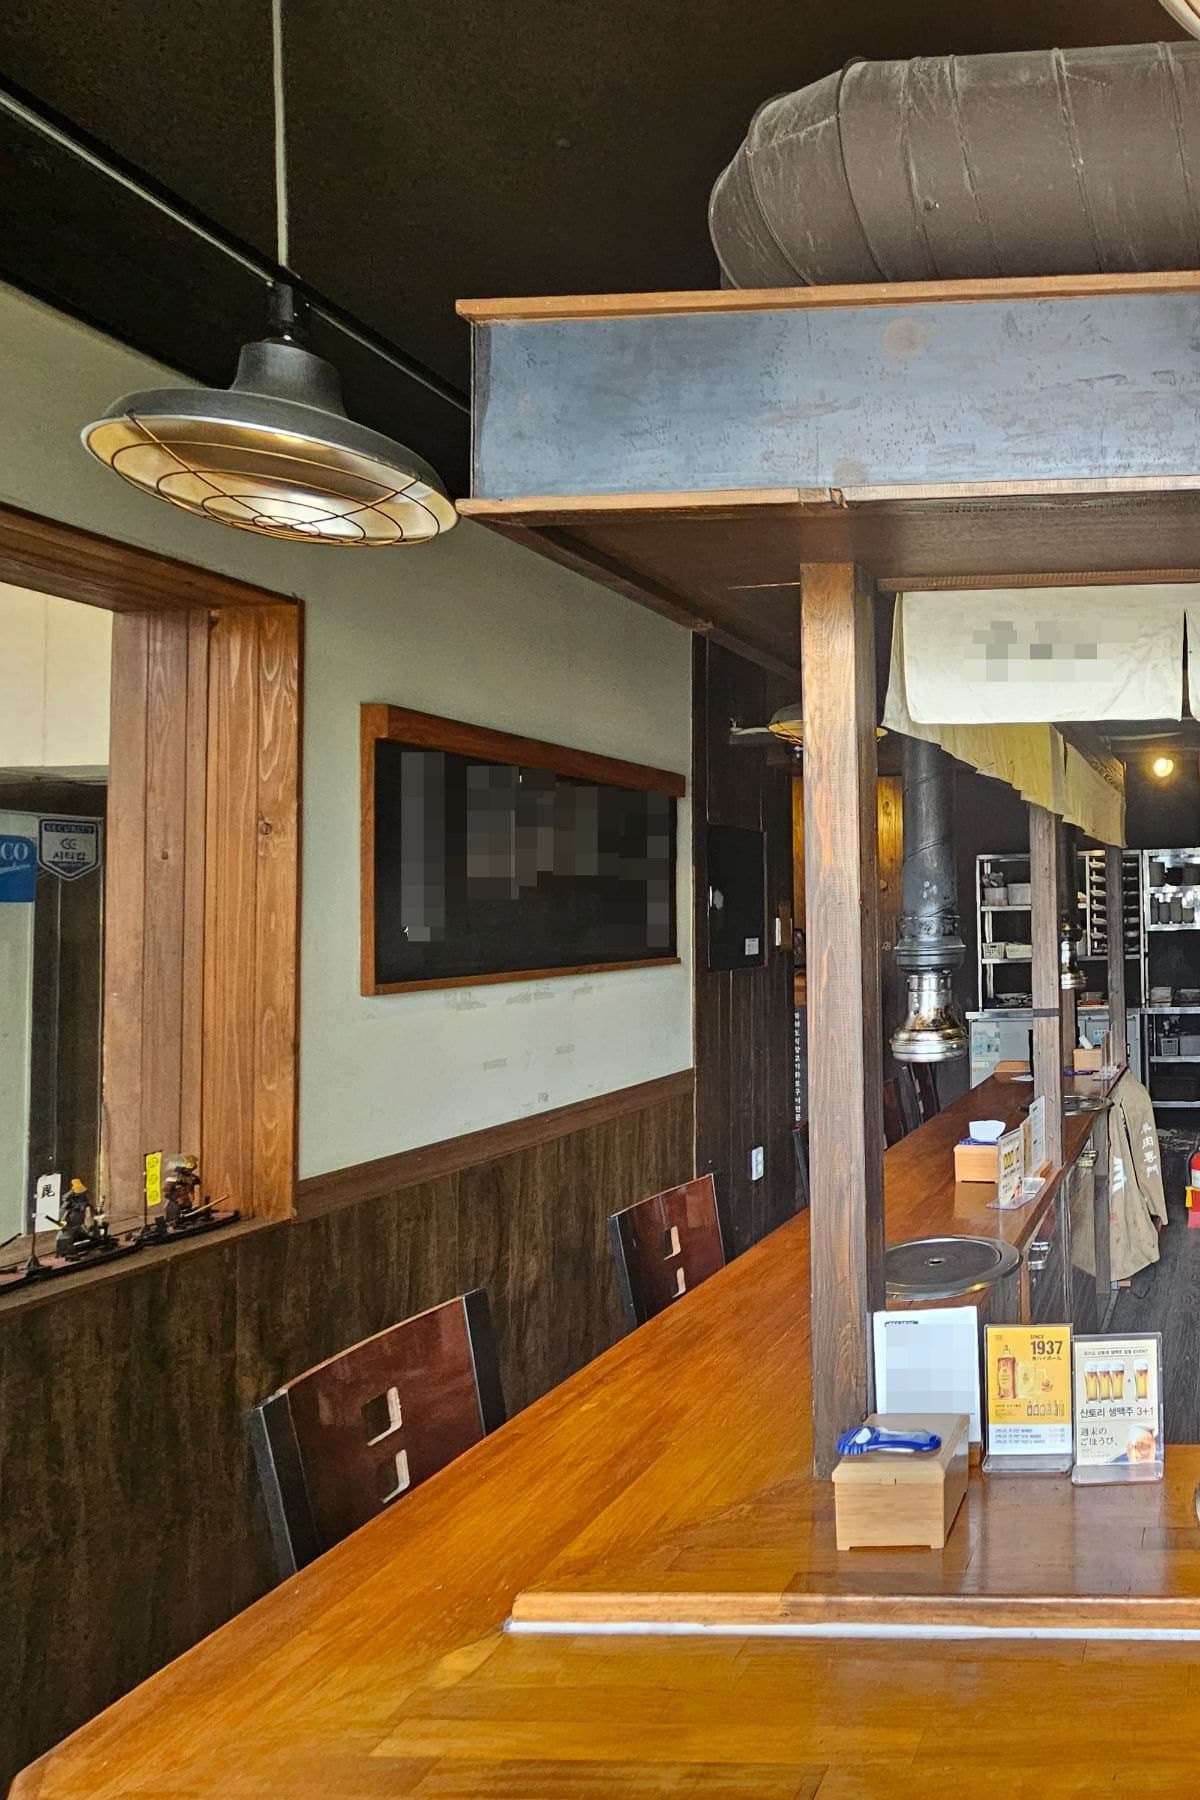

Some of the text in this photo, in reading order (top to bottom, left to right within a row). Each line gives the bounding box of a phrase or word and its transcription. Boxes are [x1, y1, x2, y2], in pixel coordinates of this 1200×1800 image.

[1030, 1340, 1063, 1355] 1937
[1079, 1406, 1154, 1418] 산토리 생맥주 3+1
